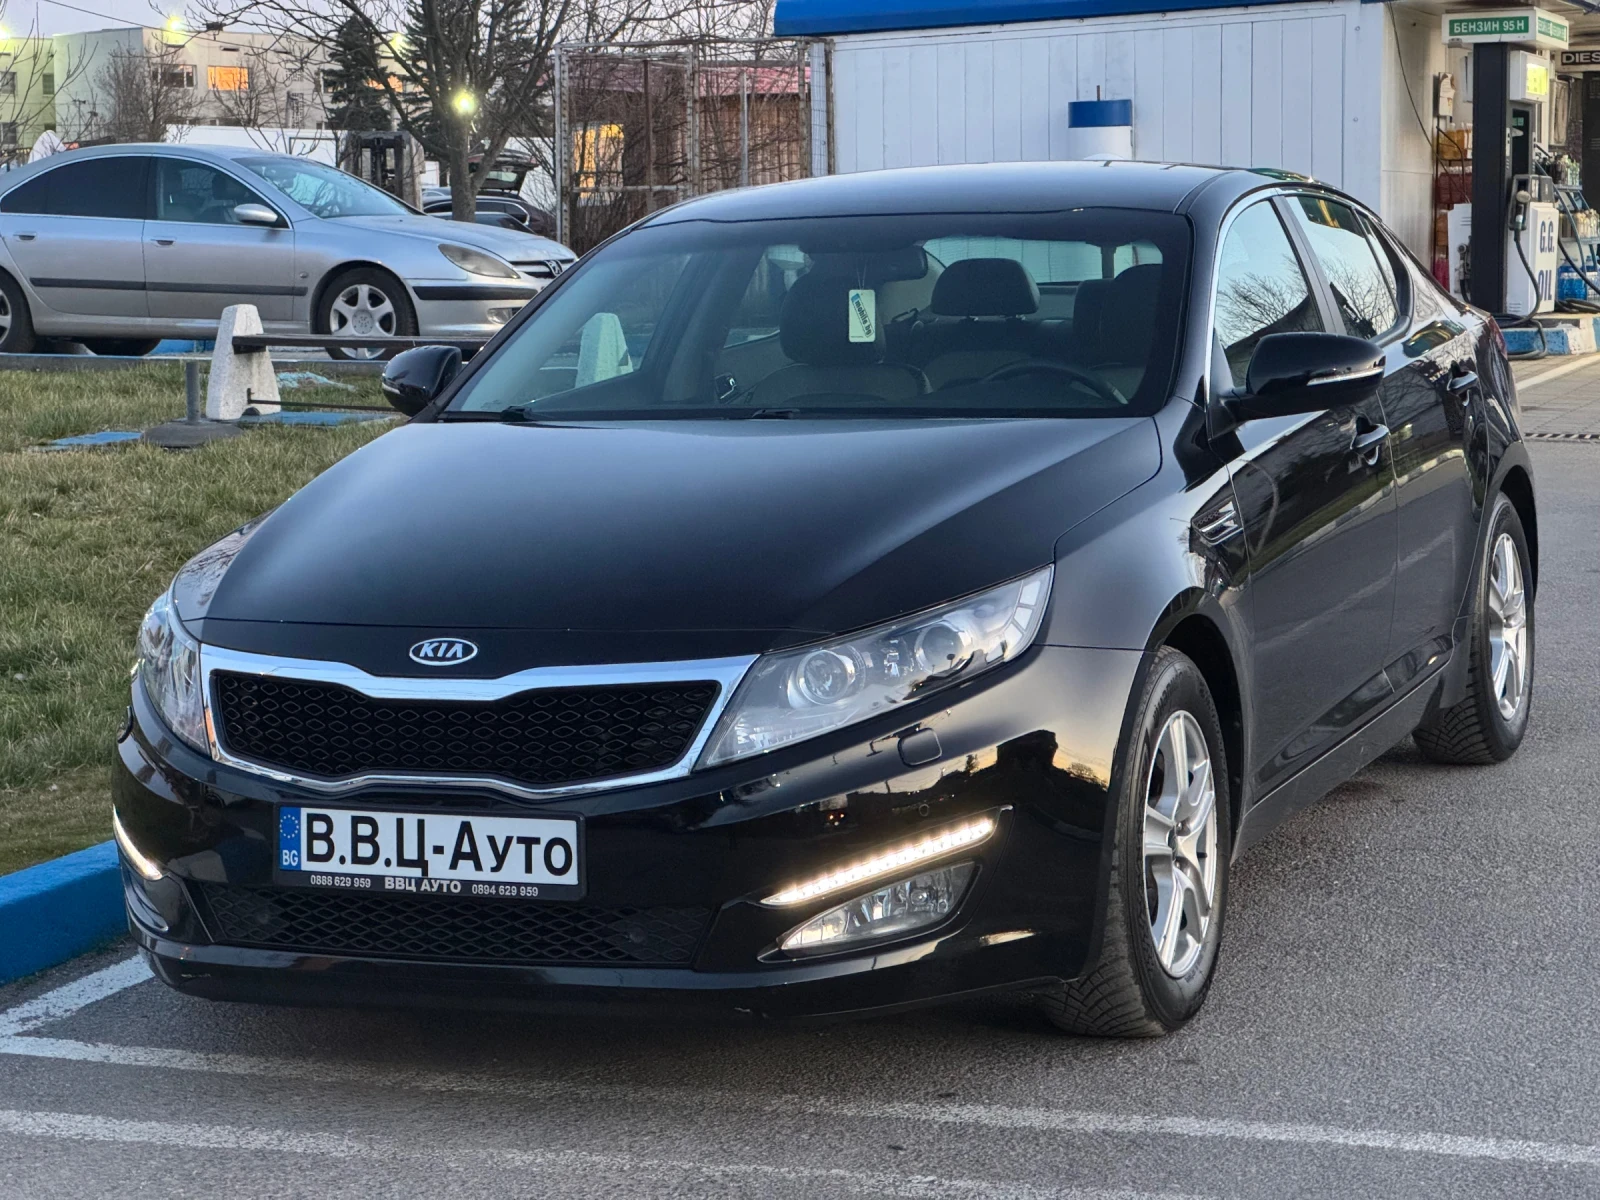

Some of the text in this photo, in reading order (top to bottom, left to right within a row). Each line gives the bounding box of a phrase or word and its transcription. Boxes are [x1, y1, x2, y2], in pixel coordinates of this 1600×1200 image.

[1453, 20, 1500, 33] БЕНЗИН
[1502, 20, 1515, 31] 95
[1538, 269, 1553, 301] OIL
[419, 642, 463, 658] KIA
[305, 812, 573, 877] В.В.Ц-Ауто
[282, 849, 299, 867] BG
[310, 874, 539, 897] 0888 629 959 ВВЦ АУТО 0894 629 959
